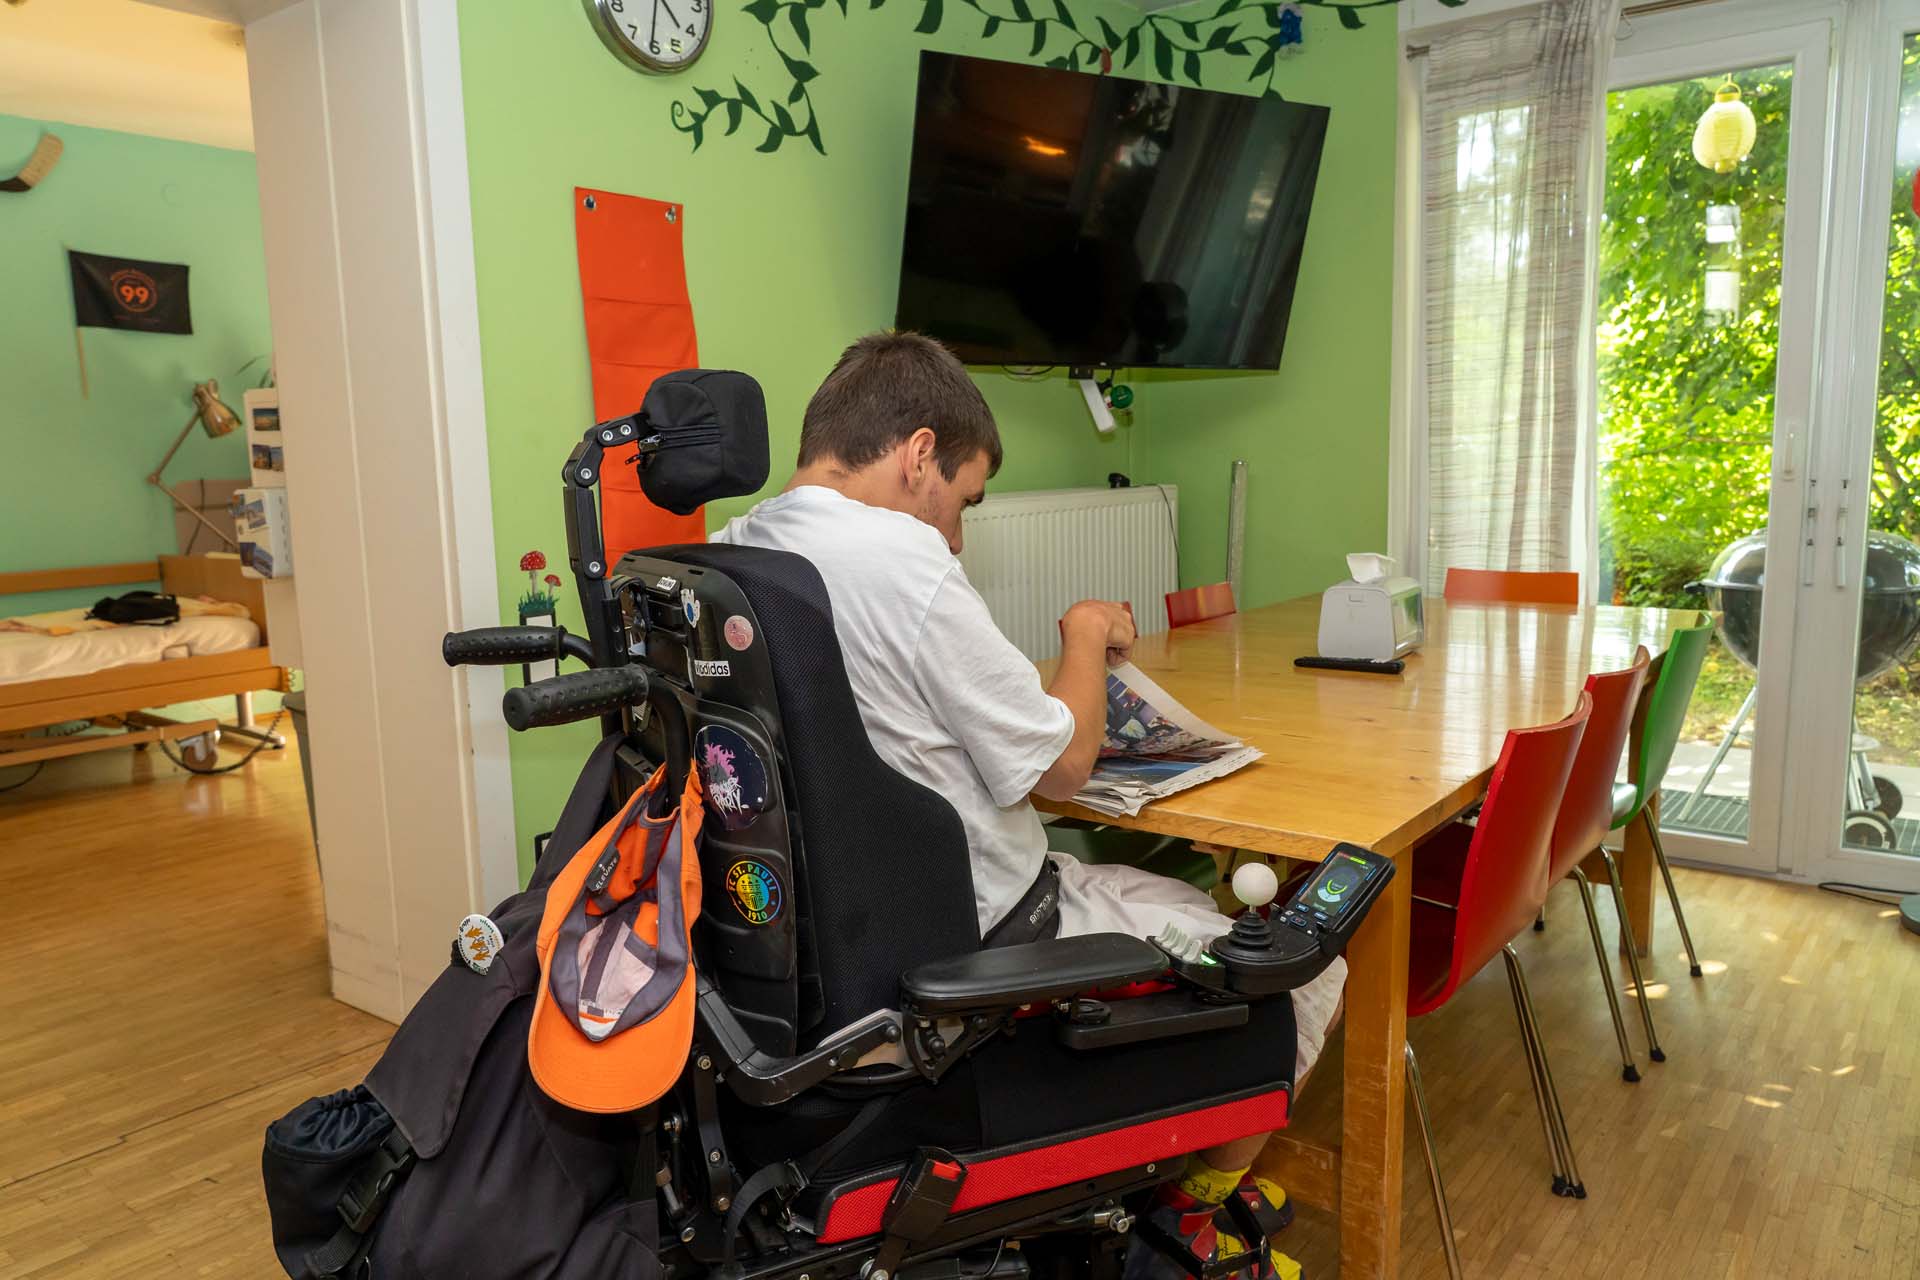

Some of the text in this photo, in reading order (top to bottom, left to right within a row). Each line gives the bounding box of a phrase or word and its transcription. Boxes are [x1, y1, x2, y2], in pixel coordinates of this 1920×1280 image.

[611, 0, 624, 13] 8
[691, 0, 702, 13] 3
[628, 24, 638, 40] 7
[686, 24, 696, 37] 4
[649, 40, 661, 55] 6
[670, 38, 681, 54] 5
[120, 285, 149, 303] 99
[732, 865, 746, 879] ST.
[747, 863, 777, 891] PAULI
[747, 910, 768, 921] 1910
